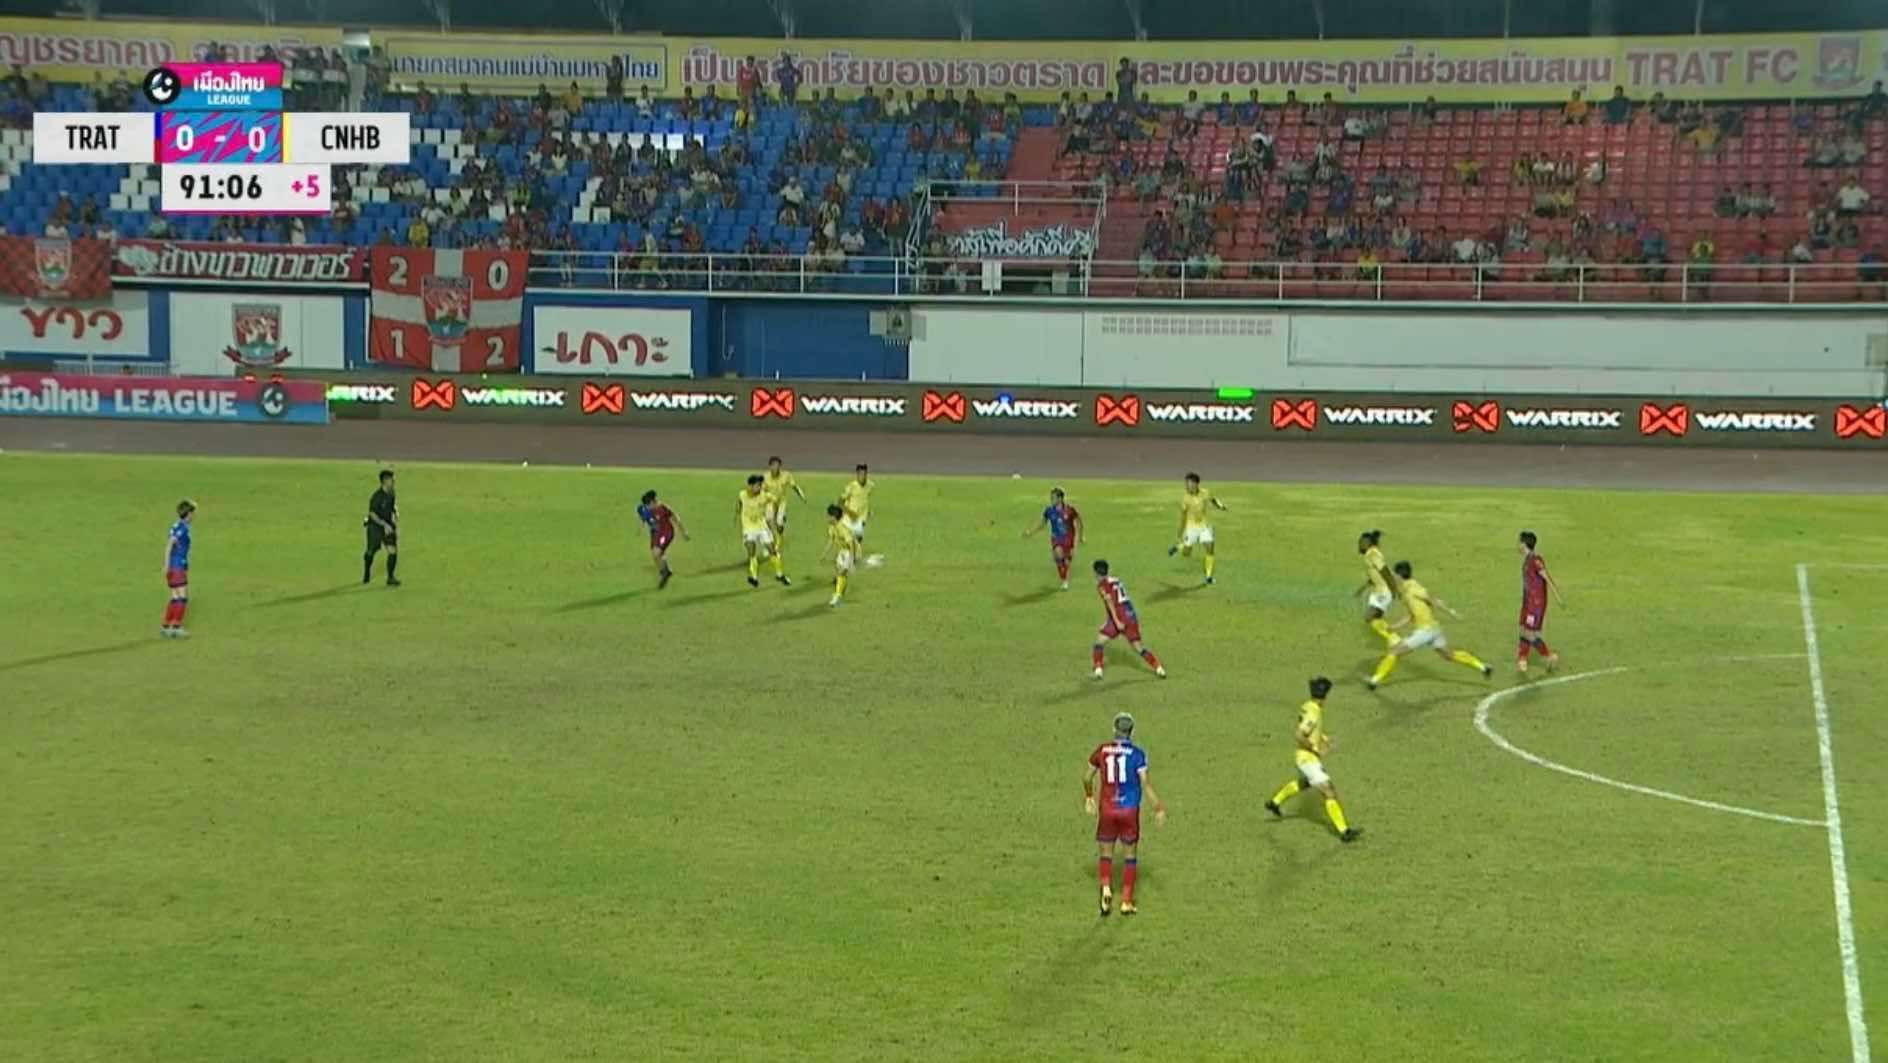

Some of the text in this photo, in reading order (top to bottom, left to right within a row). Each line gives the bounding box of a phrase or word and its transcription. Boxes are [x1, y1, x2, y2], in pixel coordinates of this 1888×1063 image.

[393, 53, 659, 79] นายกสมาคมแม่บ้านมหาไทย
[1626, 48, 1734, 86] TRAT
[1744, 48, 1798, 84] FC
[388, 255, 509, 291] 2 0
[389, 329, 504, 366] 1 2
[114, 388, 238, 415] LEAGUE
[462, 388, 565, 406] WARRIX
[801, 396, 905, 415] WARRIX
[973, 399, 1078, 418] WARRIX
[1147, 403, 1254, 421] WARRIX
[1324, 407, 1435, 425] WARRIX
[1506, 409, 1622, 428] WARRIX
[1696, 412, 1816, 431] WARRIX
[1105, 755, 1127, 784] 11
